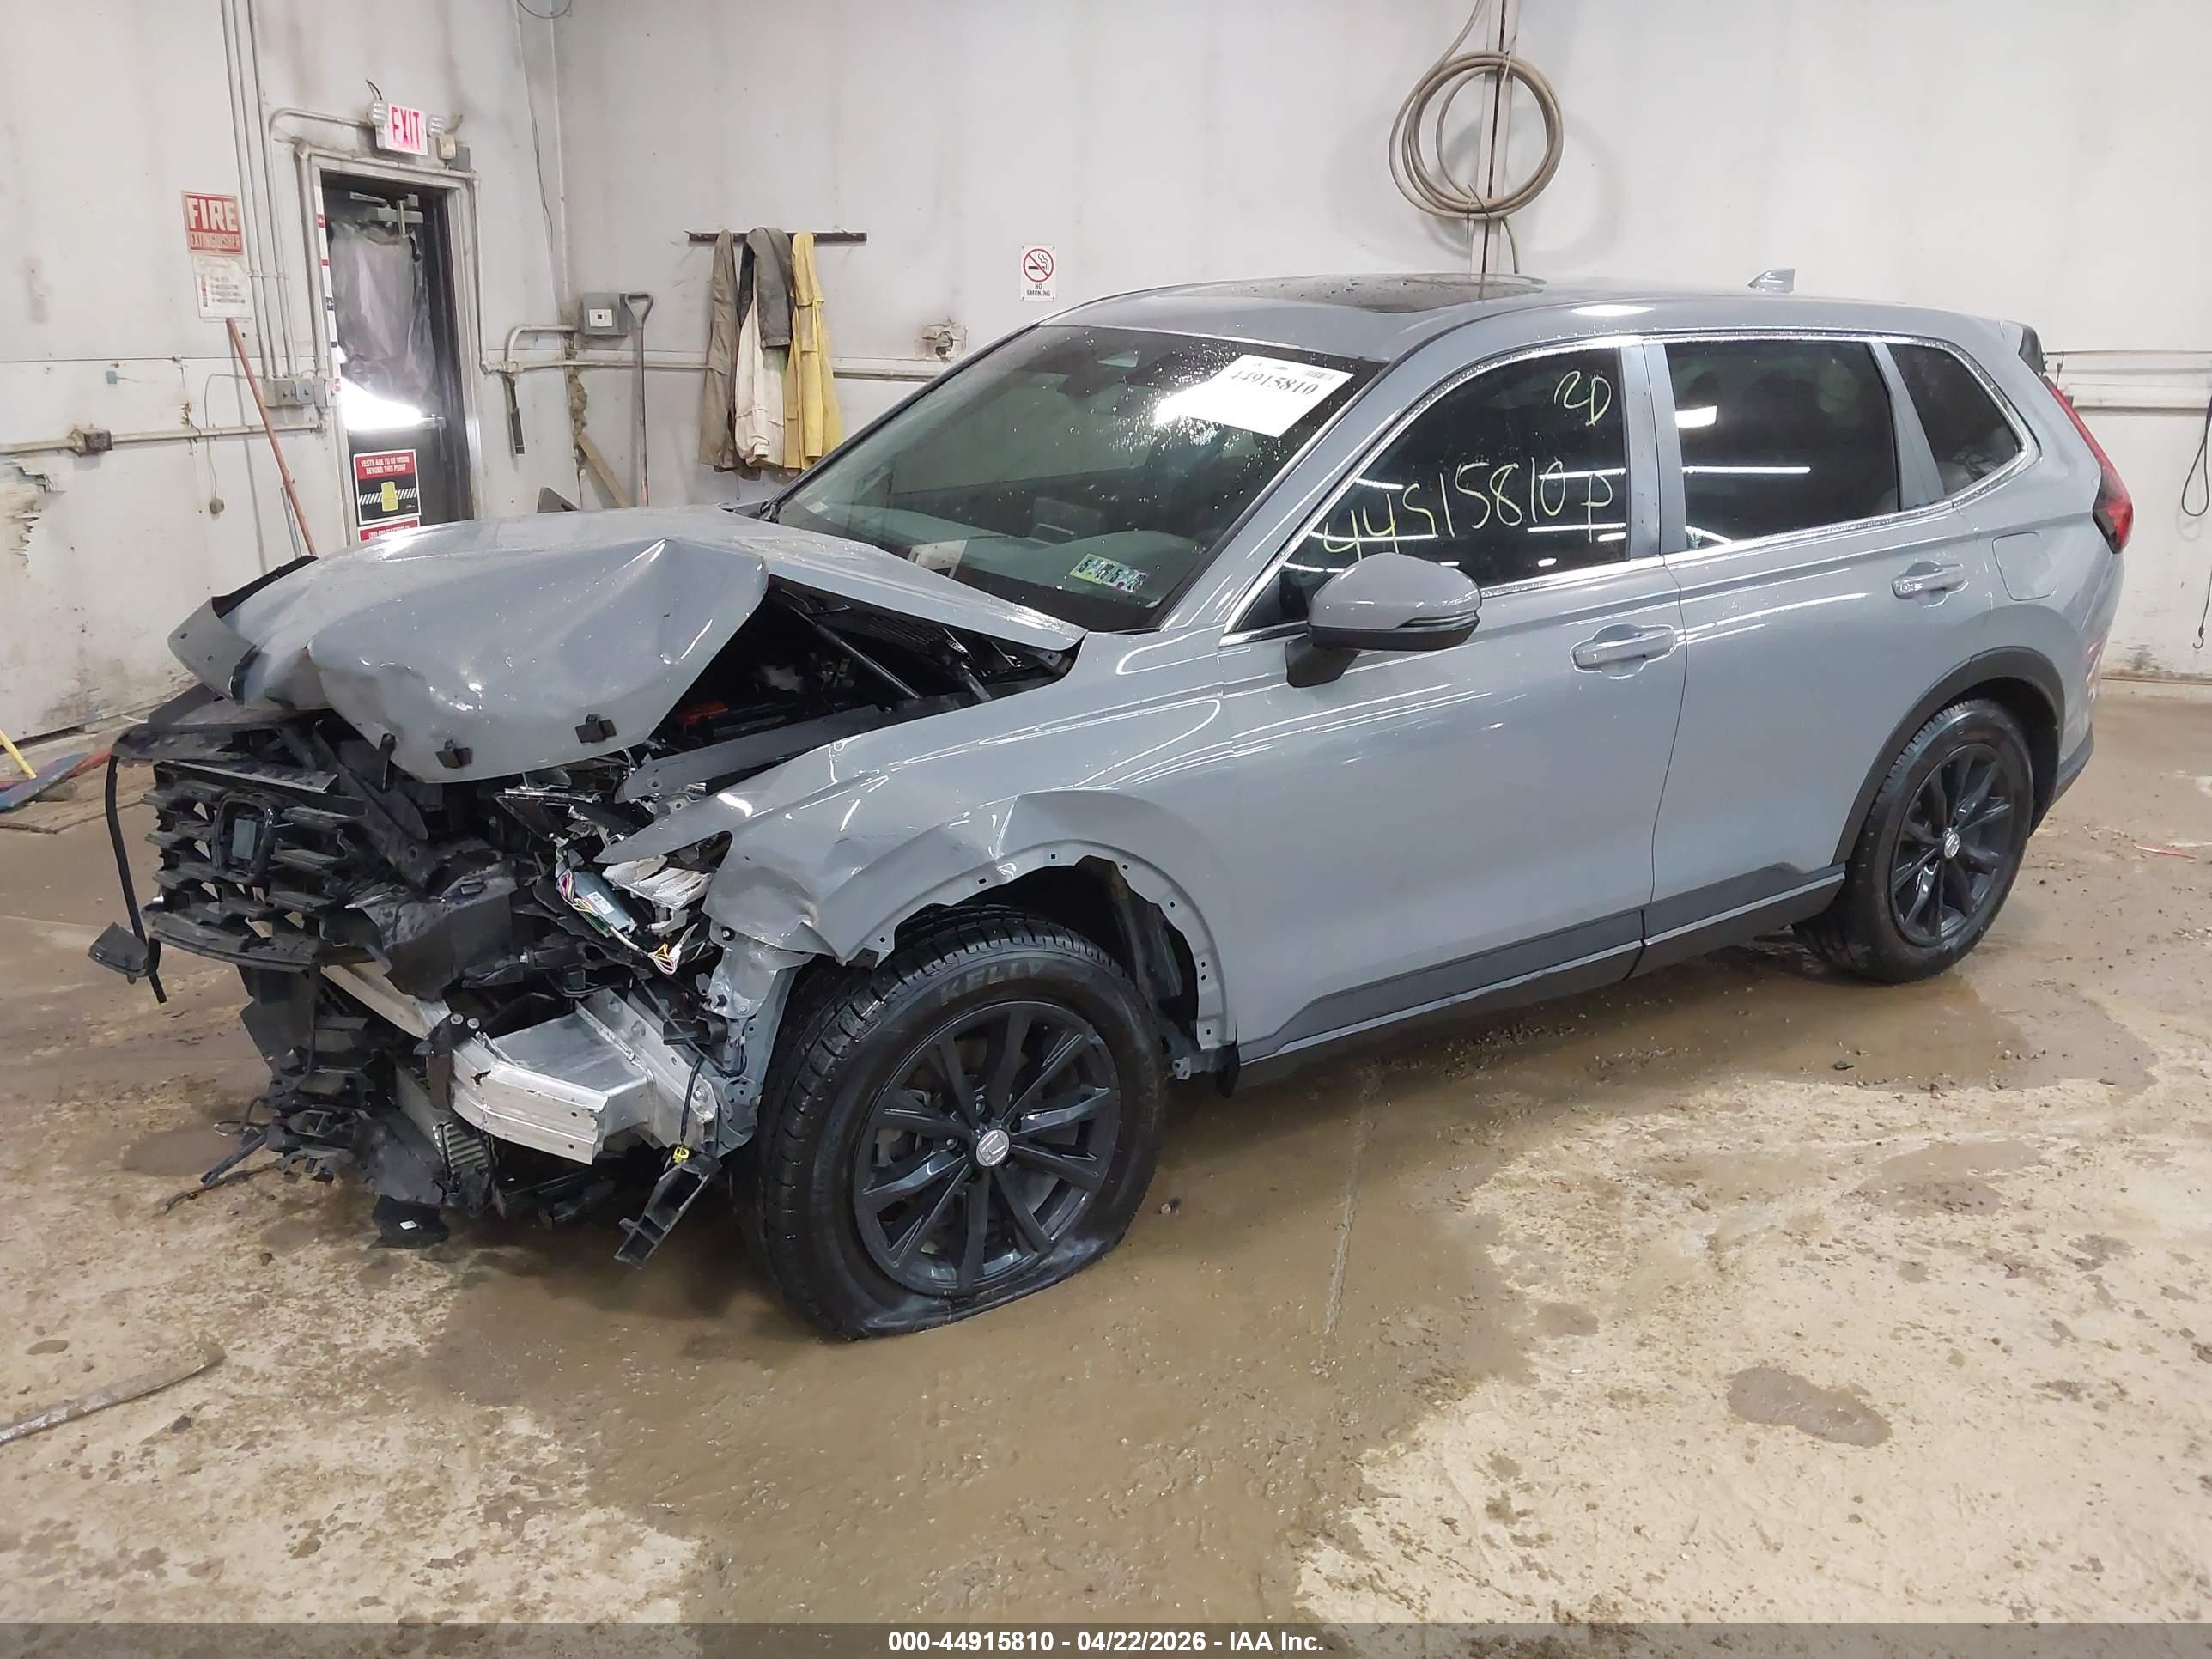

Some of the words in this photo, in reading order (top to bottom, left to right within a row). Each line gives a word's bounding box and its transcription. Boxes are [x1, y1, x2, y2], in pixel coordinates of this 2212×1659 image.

[391, 106, 421, 151] EXIT
[186, 198, 239, 232] FIRE
[940, 961, 1047, 1006] KELLY
